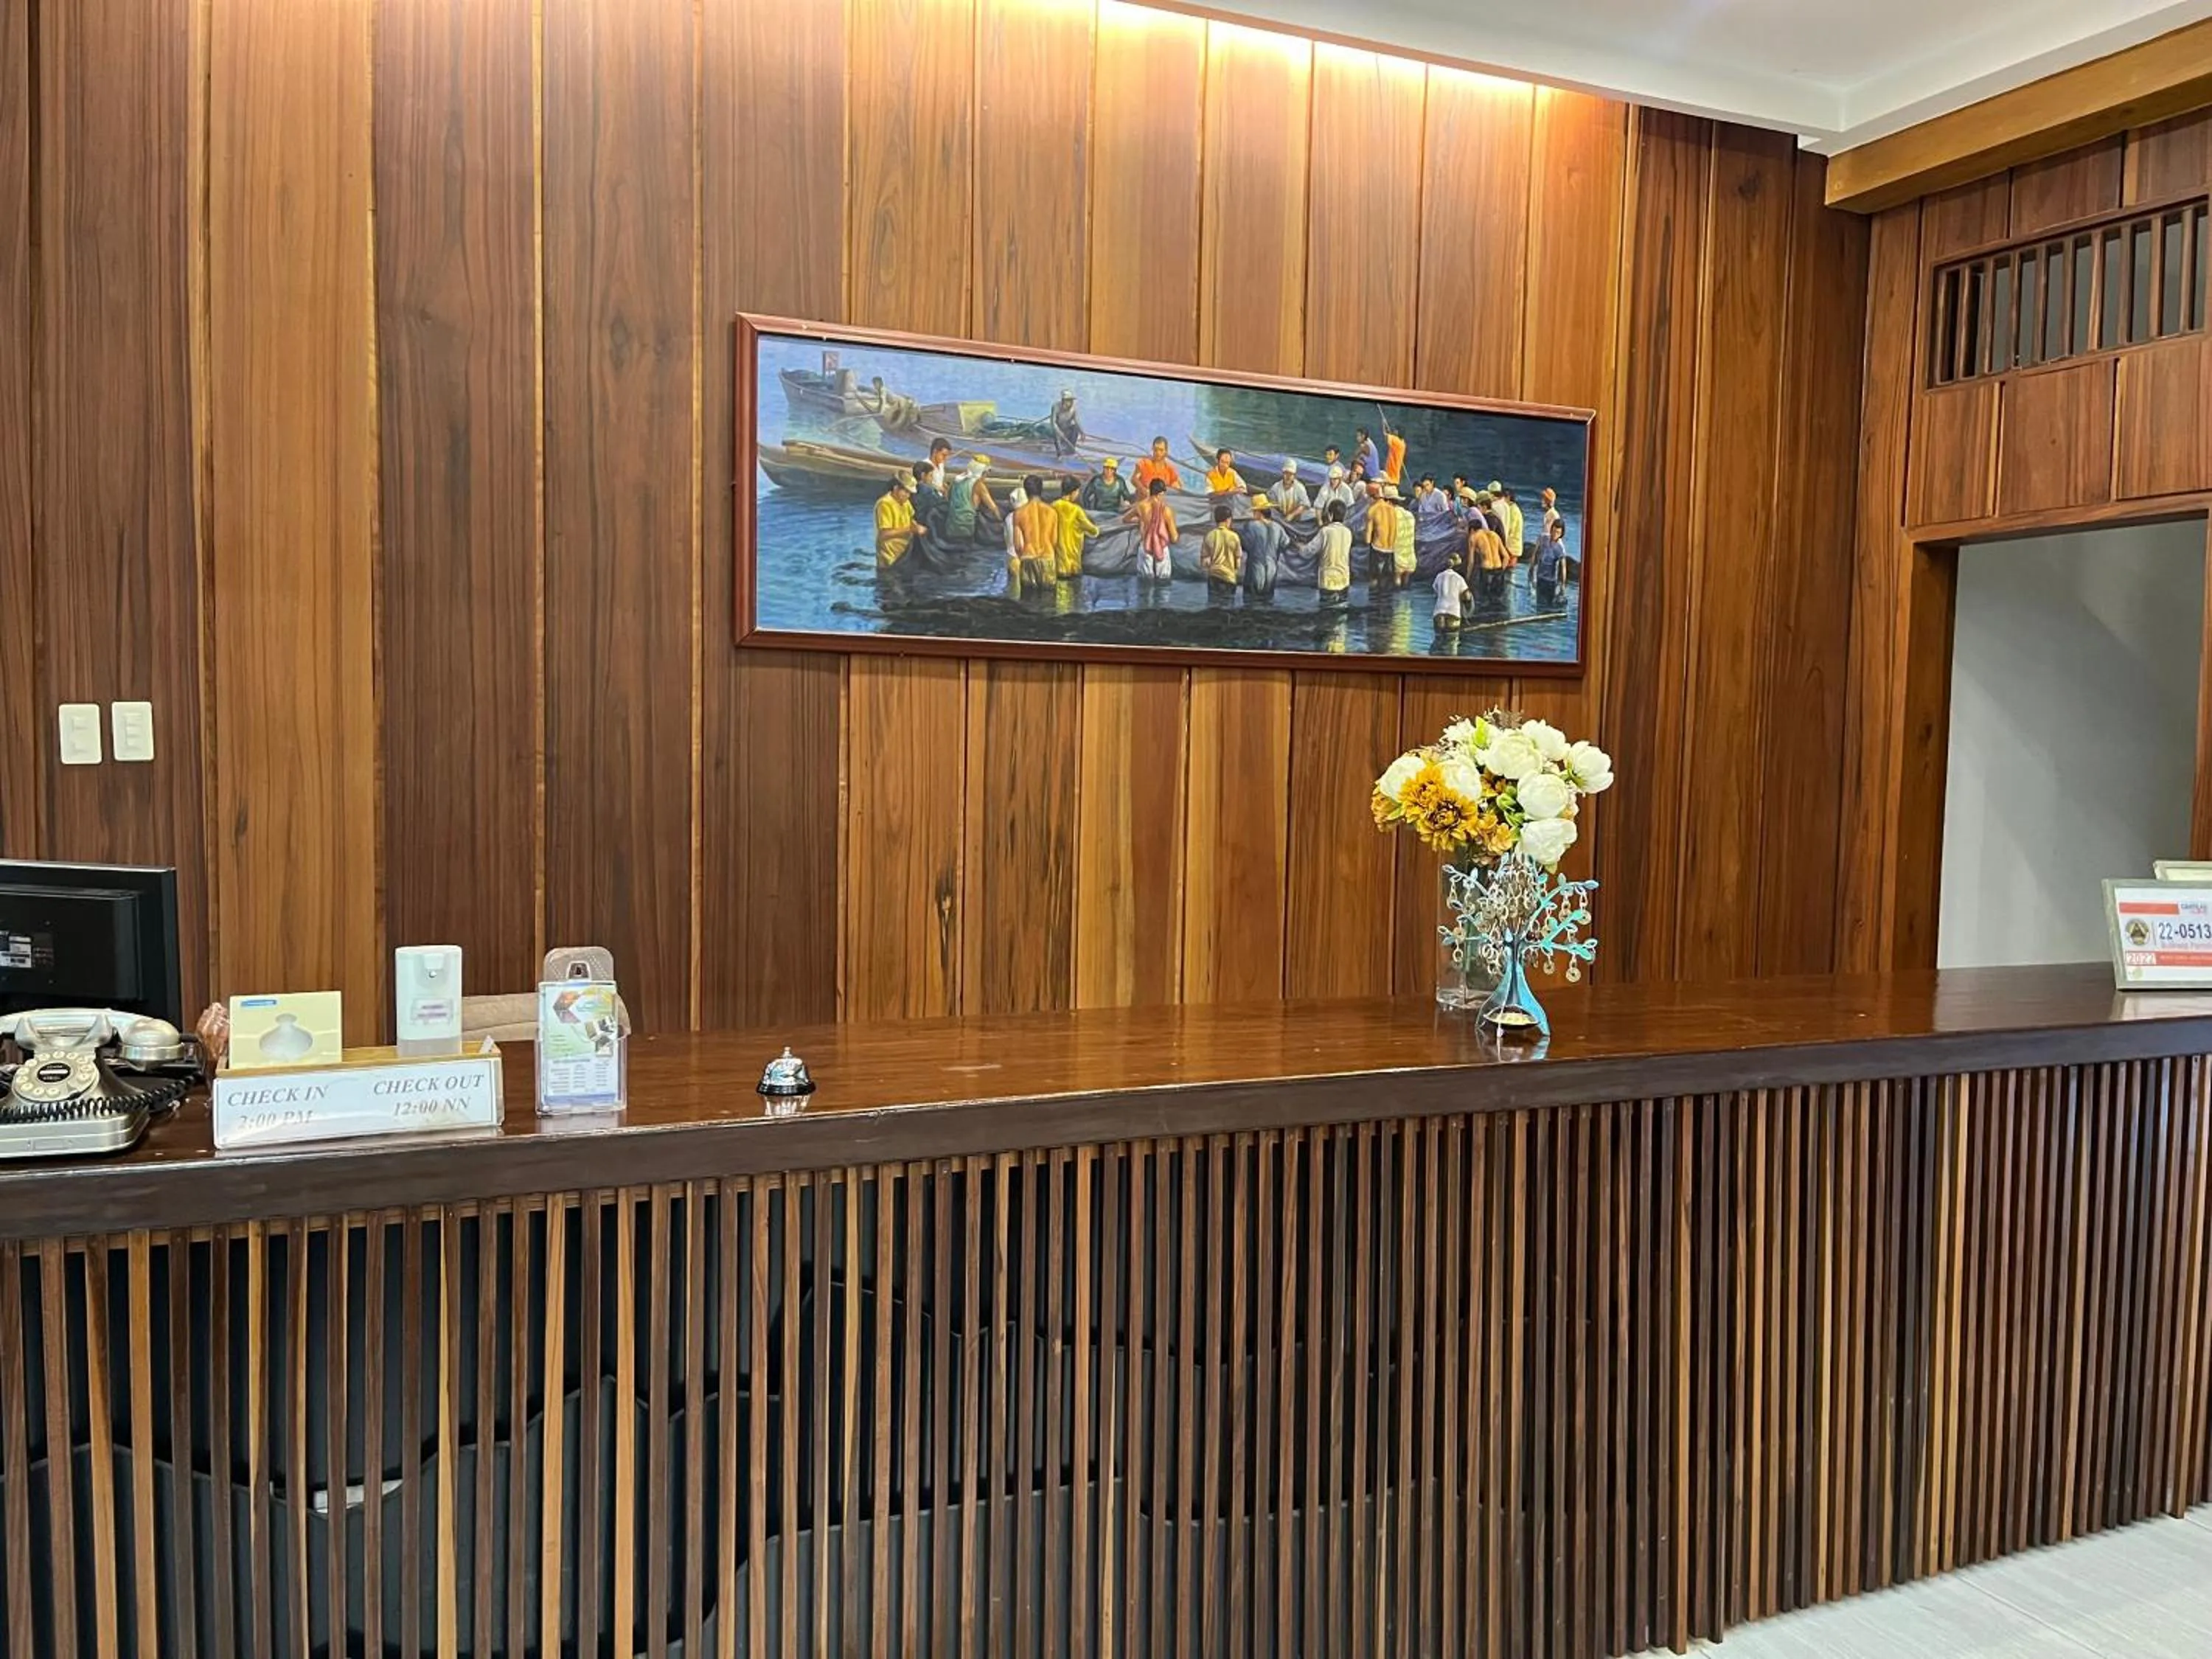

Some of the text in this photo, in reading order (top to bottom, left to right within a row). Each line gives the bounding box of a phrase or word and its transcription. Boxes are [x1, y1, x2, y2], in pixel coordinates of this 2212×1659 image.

[2158, 922, 2212, 939] 22-0513
[374, 1074, 484, 1095] CHECK OUT
[228, 1085, 329, 1106] CHECK IN
[393, 1096, 472, 1116] 12:00 NN
[237, 1110, 313, 1130] 2:00 PM
